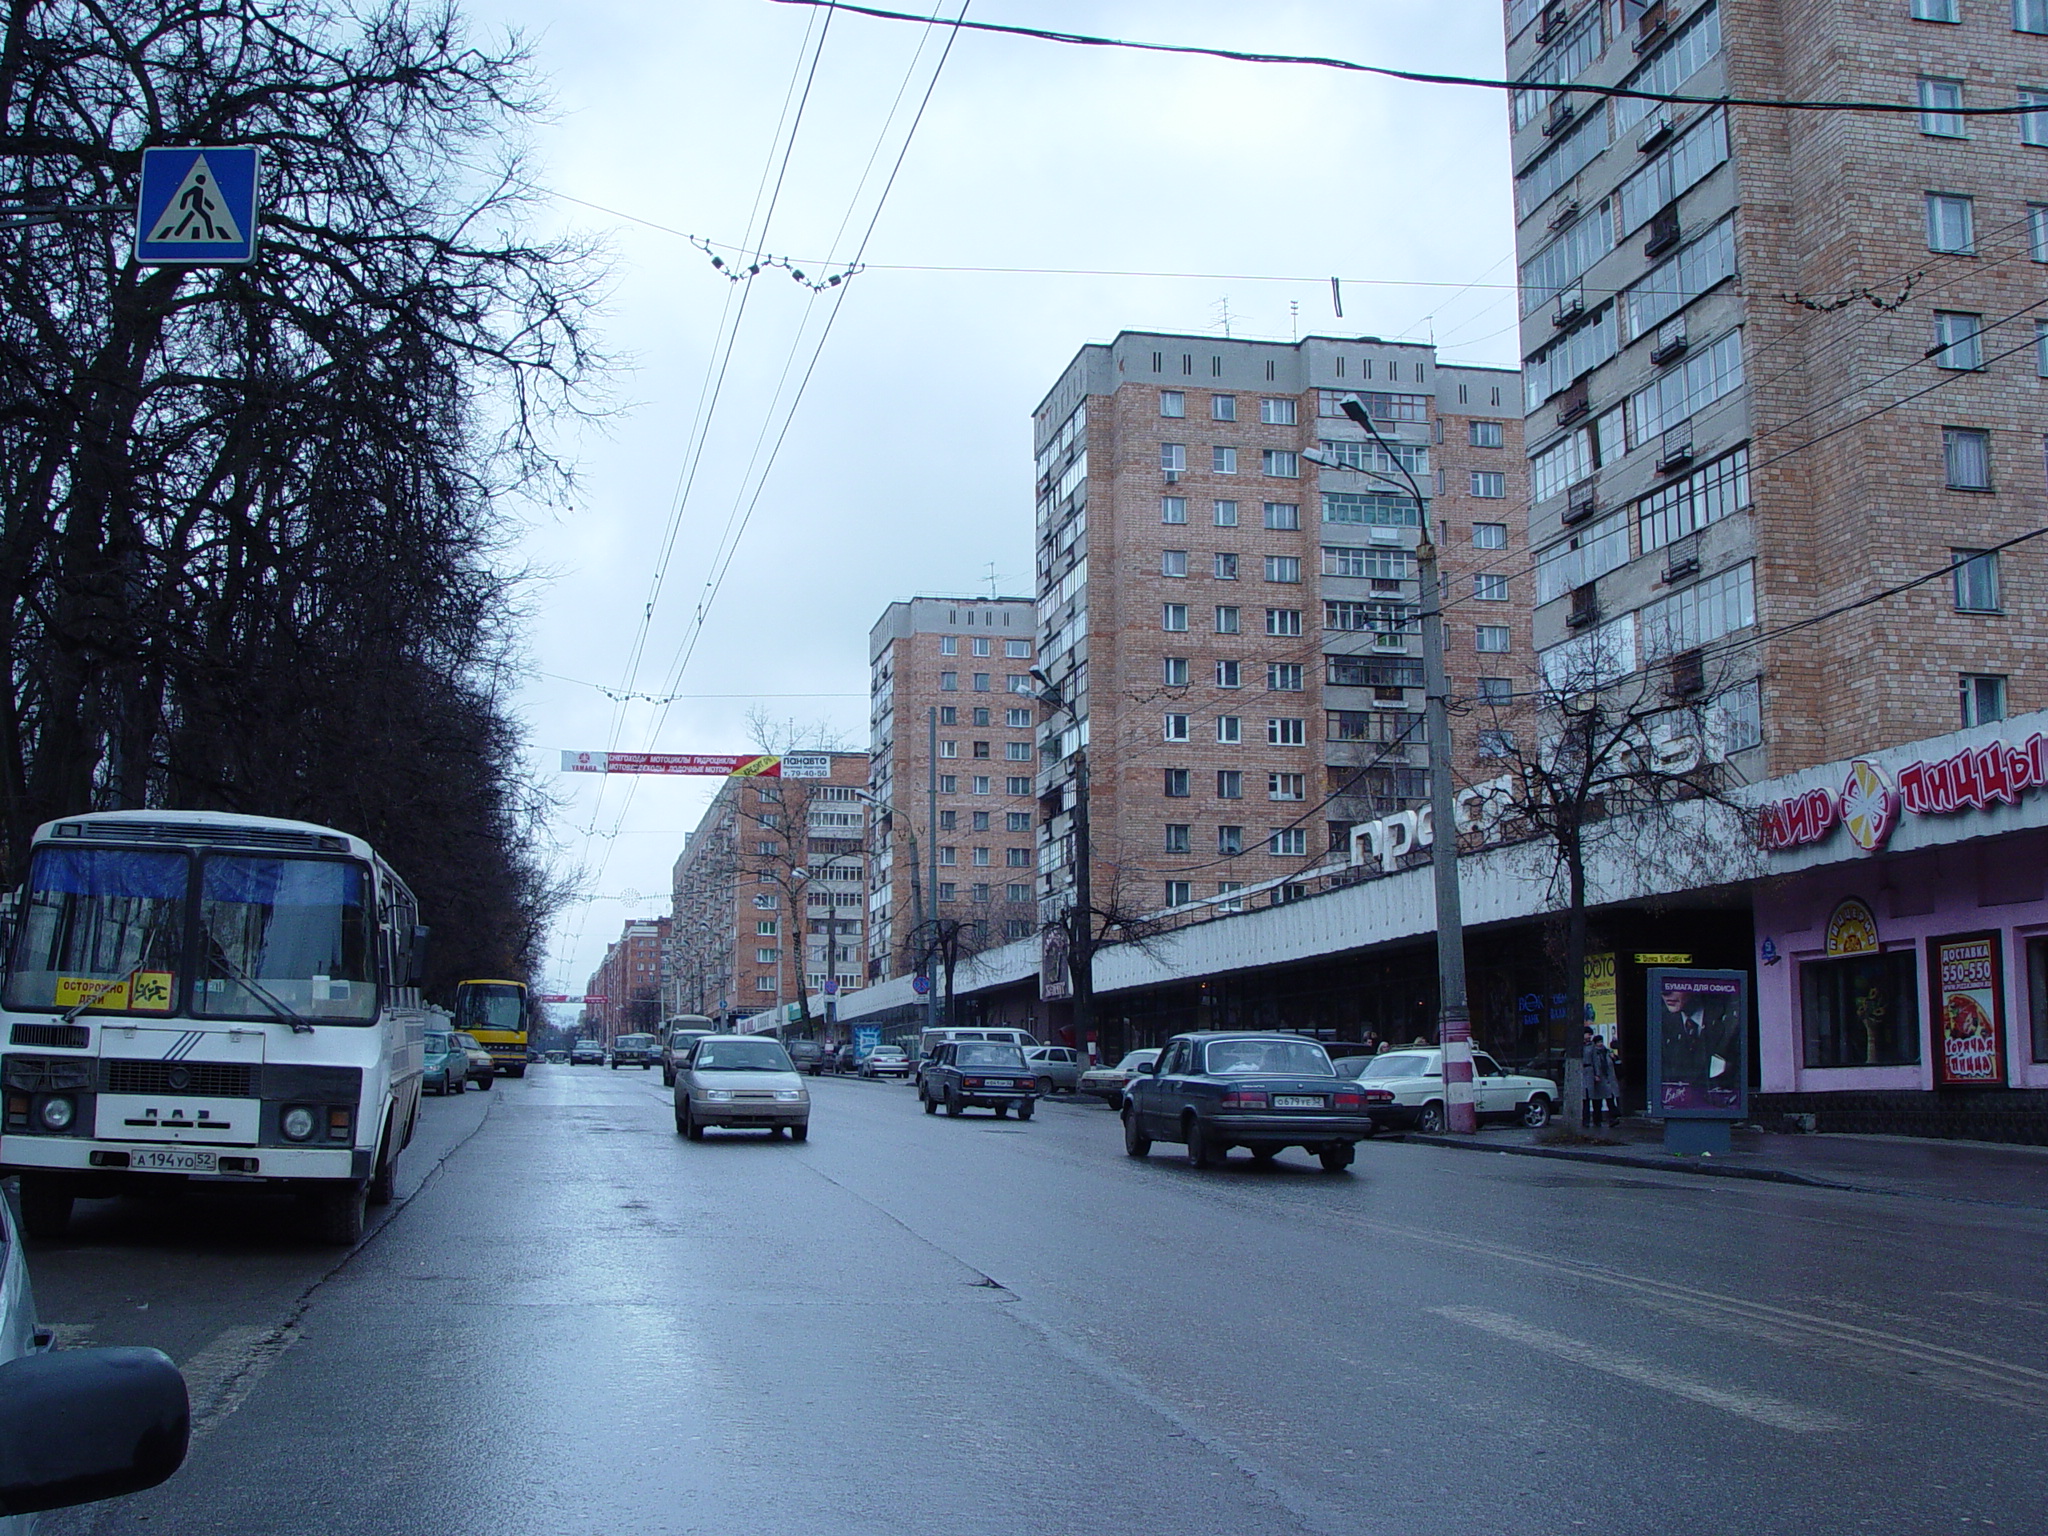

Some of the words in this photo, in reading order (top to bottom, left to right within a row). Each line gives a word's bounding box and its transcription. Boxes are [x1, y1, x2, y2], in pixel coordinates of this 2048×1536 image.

[1759, 788, 1832, 849] МИР
[1900, 733, 2045, 814] ПИЦЦЫ
[1942, 945, 1989, 963] ДОСТАВКА
[1943, 961, 1991, 982] 550-550
[1664, 983, 1692, 991] БУМАГА
[1692, 984, 1708, 992] ДЛЯ
[1709, 985, 1736, 993] ОФИСА
[1946, 1039, 1994, 1053] ГОРЯЧАЯ
[1950, 1056, 1991, 1073] ПИЦЦА
